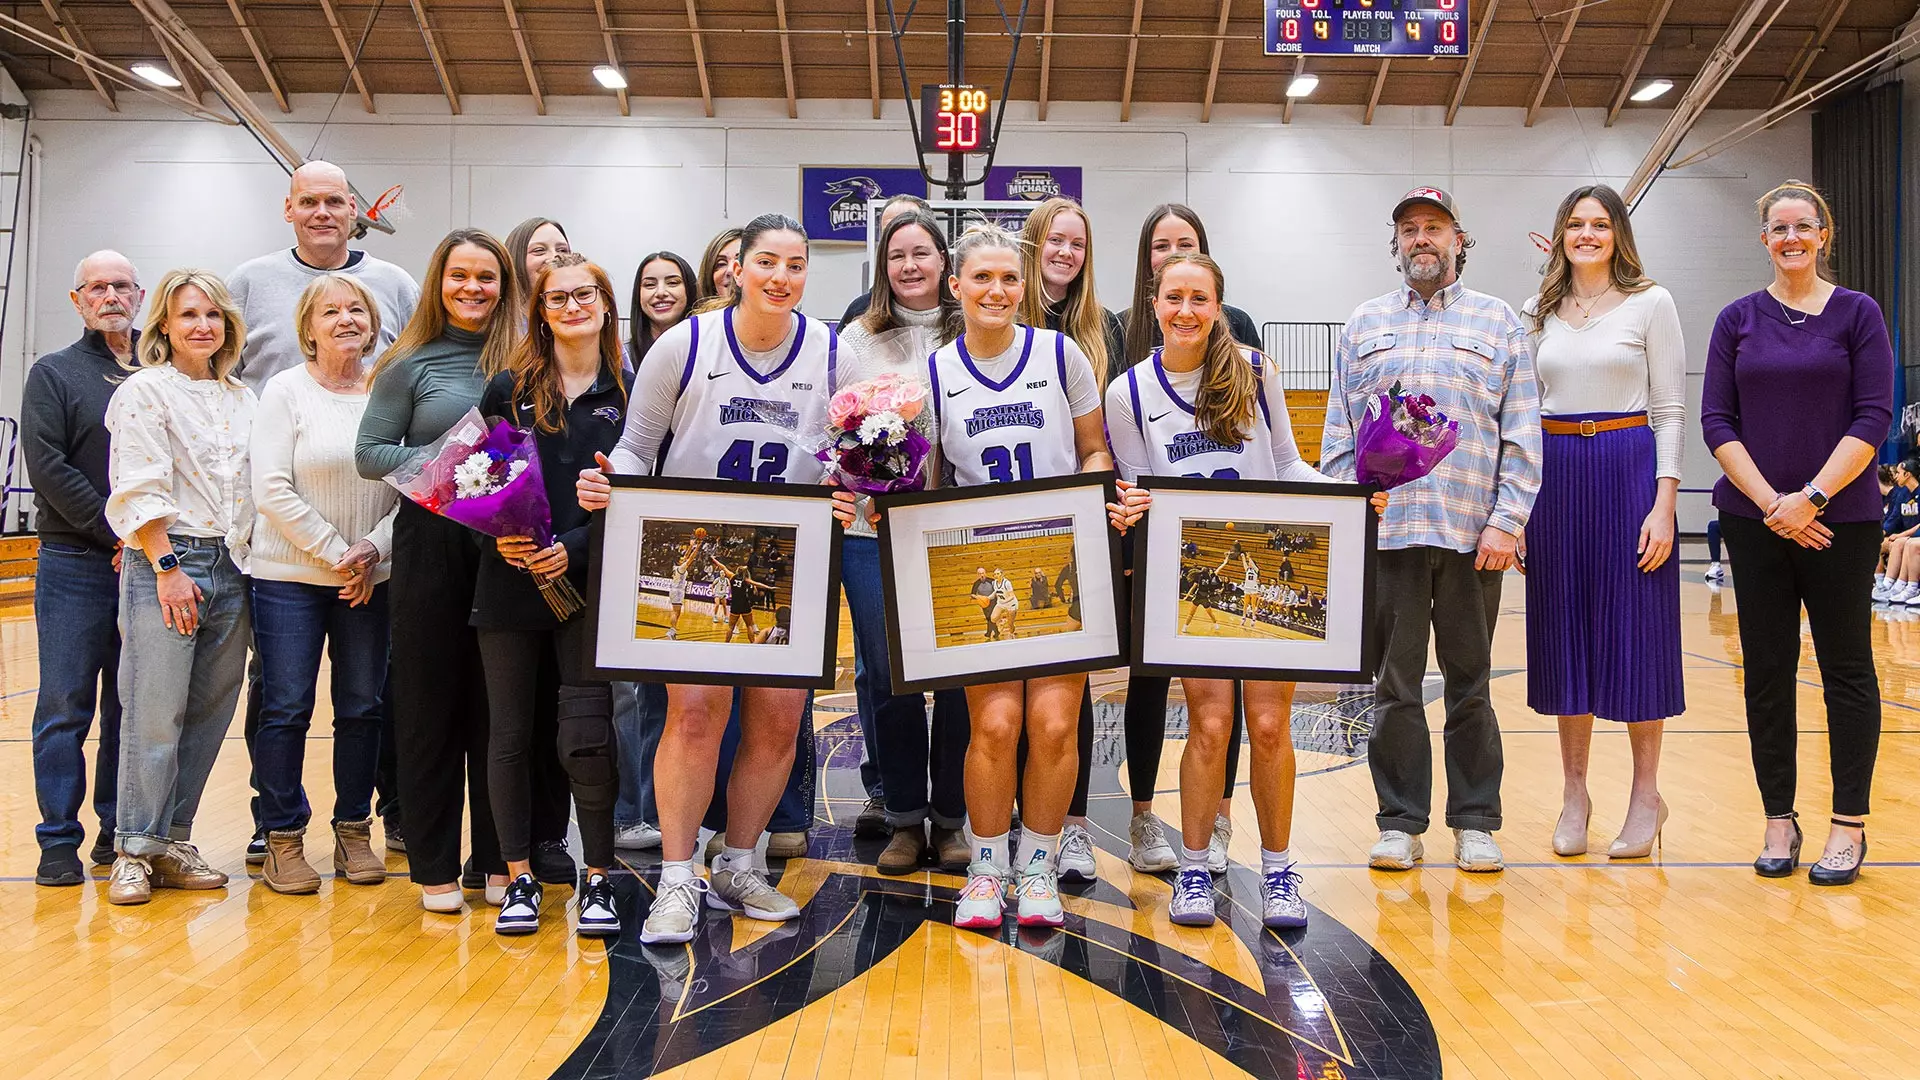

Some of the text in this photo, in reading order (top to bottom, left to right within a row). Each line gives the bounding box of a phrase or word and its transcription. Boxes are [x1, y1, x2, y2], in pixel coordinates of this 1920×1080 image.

[1276, 9, 1301, 18] FOULS
[1311, 10, 1332, 19] T.O.L.
[1342, 10, 1395, 19] PLAYER FOUL
[1404, 11, 1424, 20] T.O.L.
[1434, 12, 1459, 20] FOULS
[1314, 21, 1328, 39] 4
[1406, 22, 1420, 40] 4
[1276, 43, 1302, 52] SCORE
[1354, 44, 1380, 53] MATCH
[1433, 45, 1459, 53] SCORE
[938, 112, 977, 146] 30
[1008, 184, 1060, 196] MICHAELS
[839, 202, 868, 211] SAI
[832, 210, 868, 225] MICH
[974, 403, 1032, 418] SAINT
[967, 410, 1044, 436] MICHAELS
[1175, 432, 1206, 443] SAI
[717, 439, 789, 483] 42
[981, 442, 1034, 482] 31
